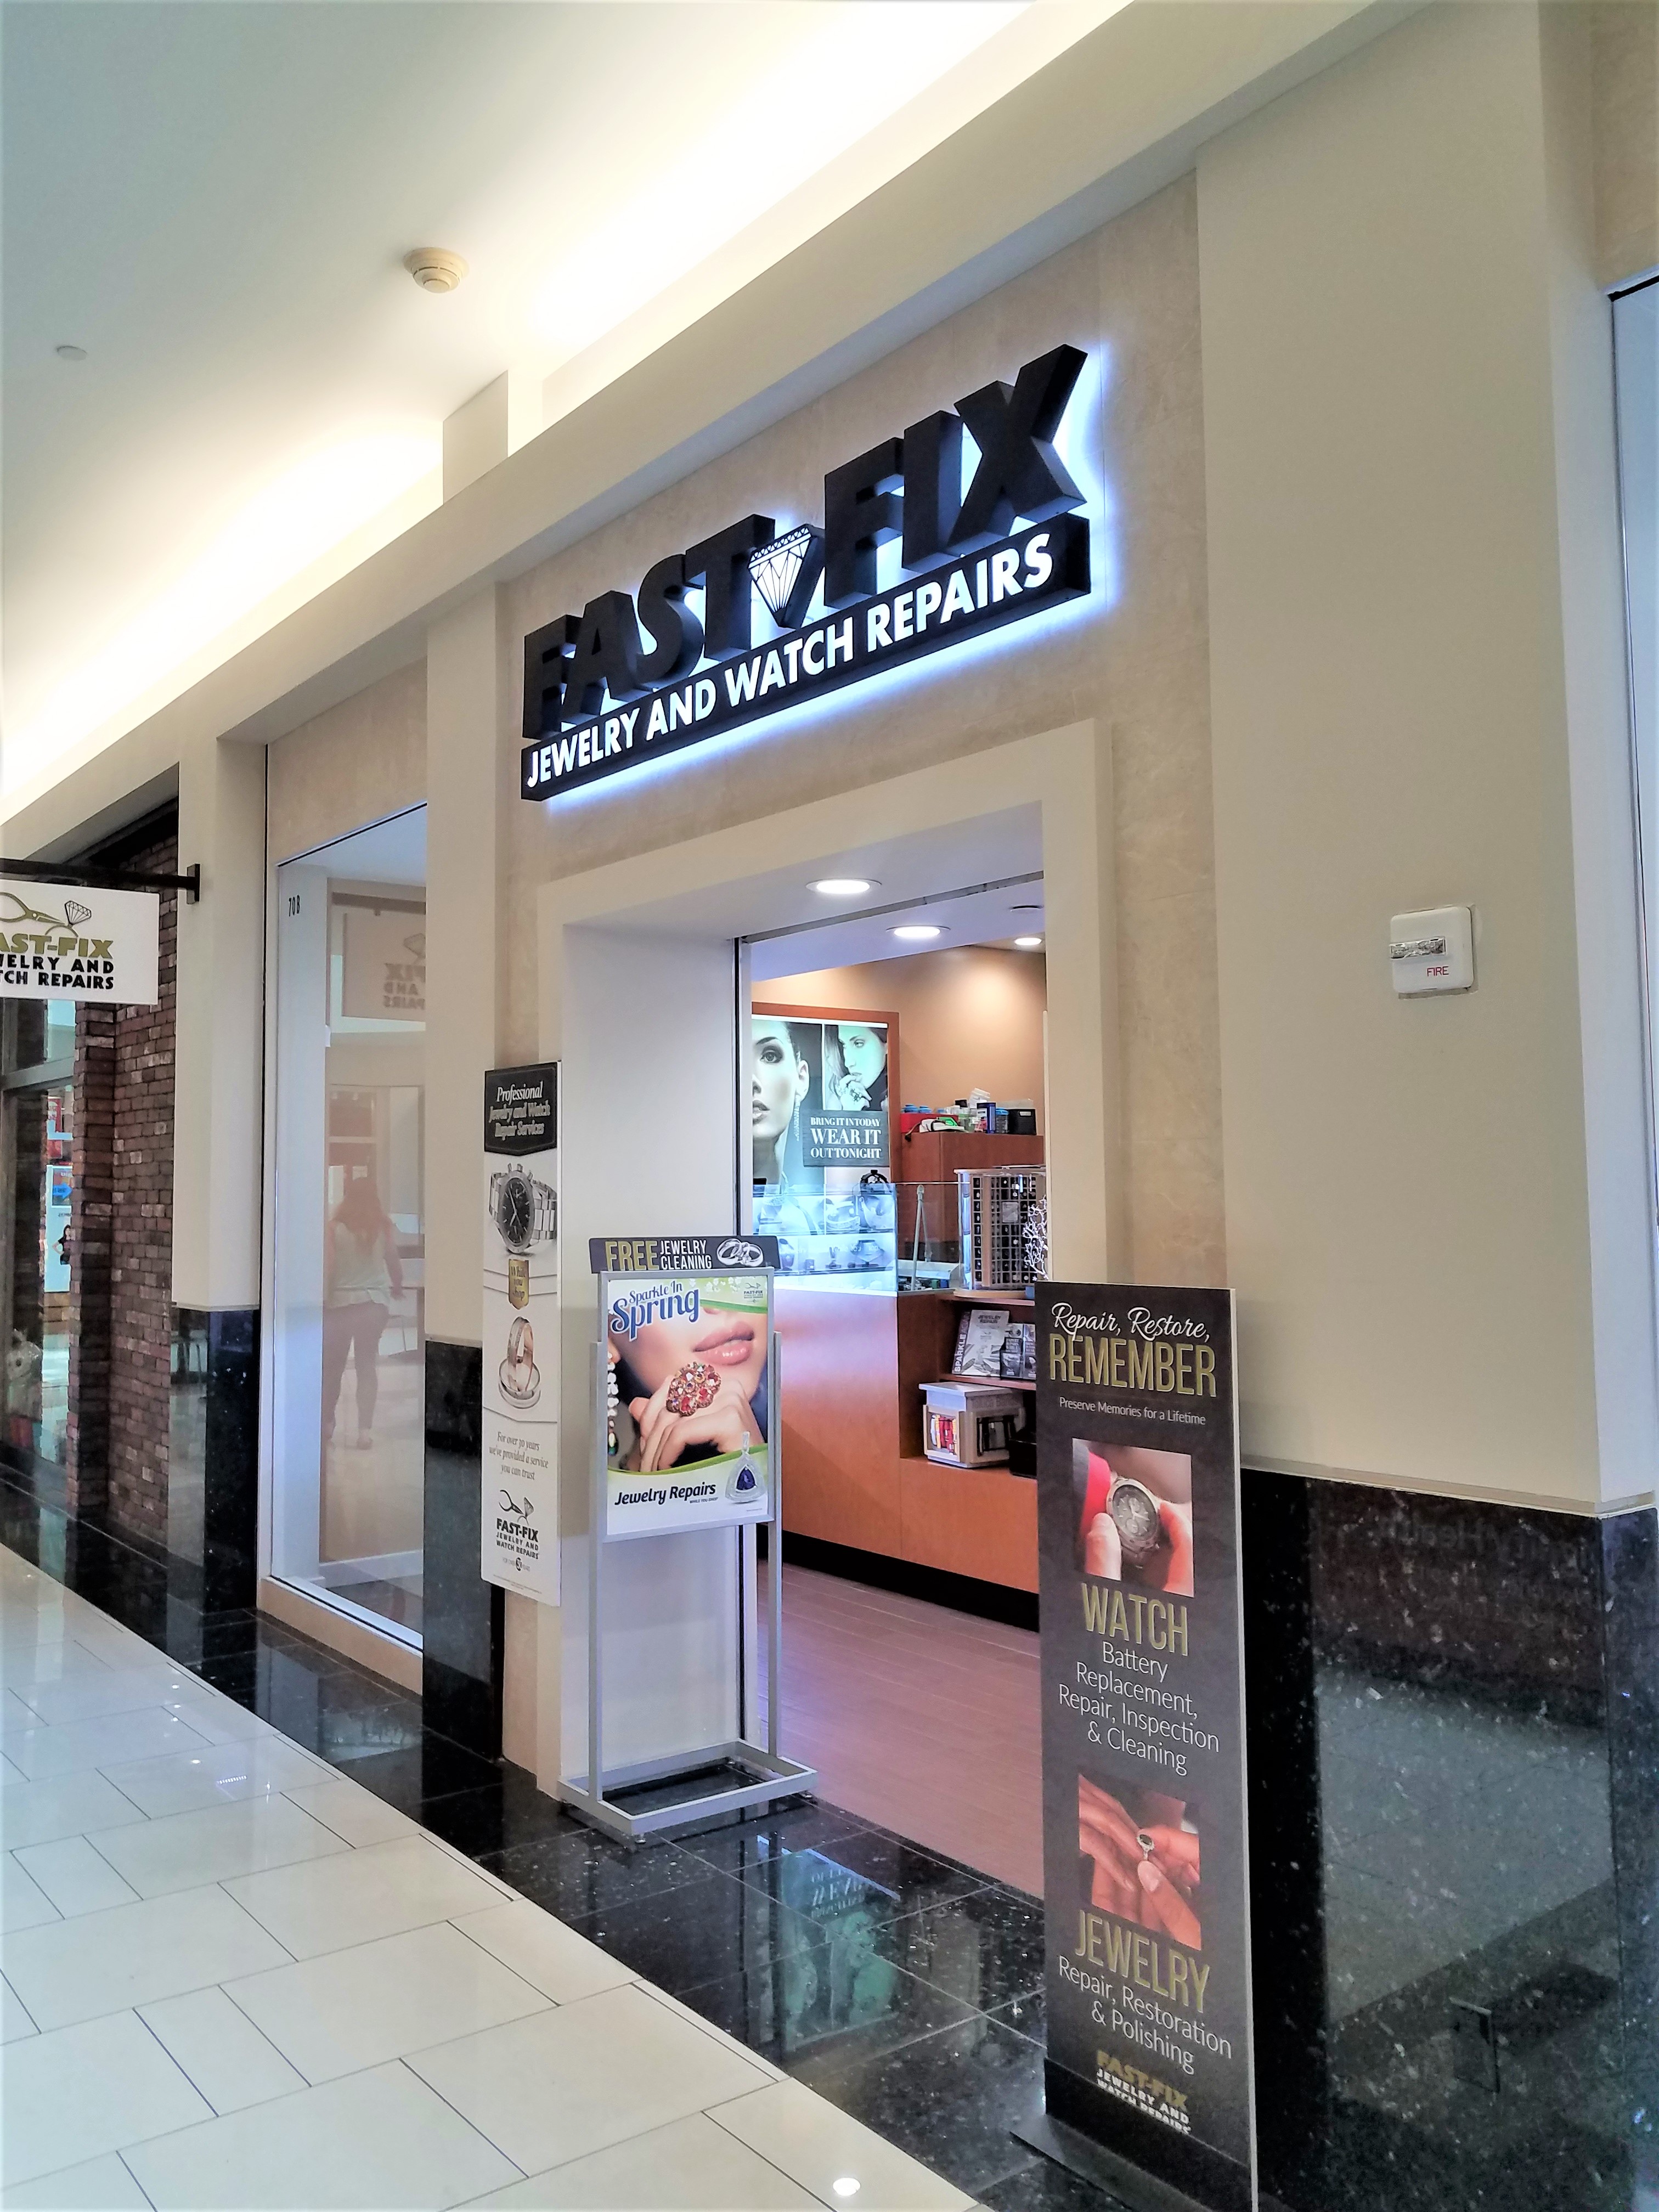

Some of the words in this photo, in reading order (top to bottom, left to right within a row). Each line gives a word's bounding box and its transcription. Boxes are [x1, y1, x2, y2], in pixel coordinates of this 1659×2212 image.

[523, 514, 775, 740] FAST
[824, 343, 1088, 611] FIX
[527, 708, 640, 788] JEWELRY
[646, 679, 716, 741] AND
[725, 617, 854, 707] WATCH
[867, 533, 1052, 652] REPAIRS
[0, 953, 60, 970] ELRY
[71, 959, 114, 974] AND
[0, 970, 28, 984] CH
[38, 972, 114, 990] REPAIRS
[1426, 966, 1449, 977] FIRE
[496, 1080, 543, 1105] Professional
[810, 1117, 835, 1126] BRING
[810, 1128, 861, 1145] WEAR
[864, 1129, 882, 1145] IT
[810, 1148, 833, 1158] OUT
[834, 1148, 882, 1159] TONIGHT
[605, 1240, 659, 1271] FREE
[660, 1240, 706, 1255] JEWELRY
[661, 1254, 712, 1270] CLEANING
[629, 1284, 669, 1305] Sparkle
[670, 1280, 682, 1293] In
[612, 1289, 699, 1340] Spring
[1051, 1302, 1121, 1341] Repair,
[1127, 1307, 1210, 1342] Restore,
[1049, 1333, 1217, 1397] REMEMBER
[1059, 1397, 1096, 1412] Preserve
[1098, 1402, 1142, 1418] Memories
[1144, 1407, 1157, 1419] for
[1159, 1412, 1165, 1420] a
[1167, 1410, 1206, 1425] Lifetime
[614, 1487, 667, 1505] Jewelry
[669, 1481, 716, 1501] Repairs
[496, 1517, 538, 1543] FAST-FIX
[496, 1532, 523, 1545] JEWELRY
[526, 1541, 539, 1551] AND
[496, 1539, 515, 1551] WATCH
[516, 1546, 539, 1560] REPAIRS
[1081, 1583, 1188, 1657] WATCH
[1102, 1641, 1168, 1683] Battery
[1076, 1661, 1198, 1720] Replacement,
[1059, 1683, 1116, 1724] Repair,
[1122, 1702, 1220, 1753] Inspection
[1087, 1720, 1102, 1745] &
[1107, 1727, 1188, 1776] Cleaning
[1075, 1909, 1210, 2013] JEWELRY
[1059, 1954, 1116, 2006] Repair,
[1122, 1985, 1232, 2060] Restoration
[1091, 2000, 1106, 2026] &
[1112, 2008, 1195, 2075] Polishing
[1096, 2068, 1155, 2106] JEWELRY
[1160, 2102, 1190, 2125] AND
[1097, 2049, 1188, 2112] FAST-FIX
